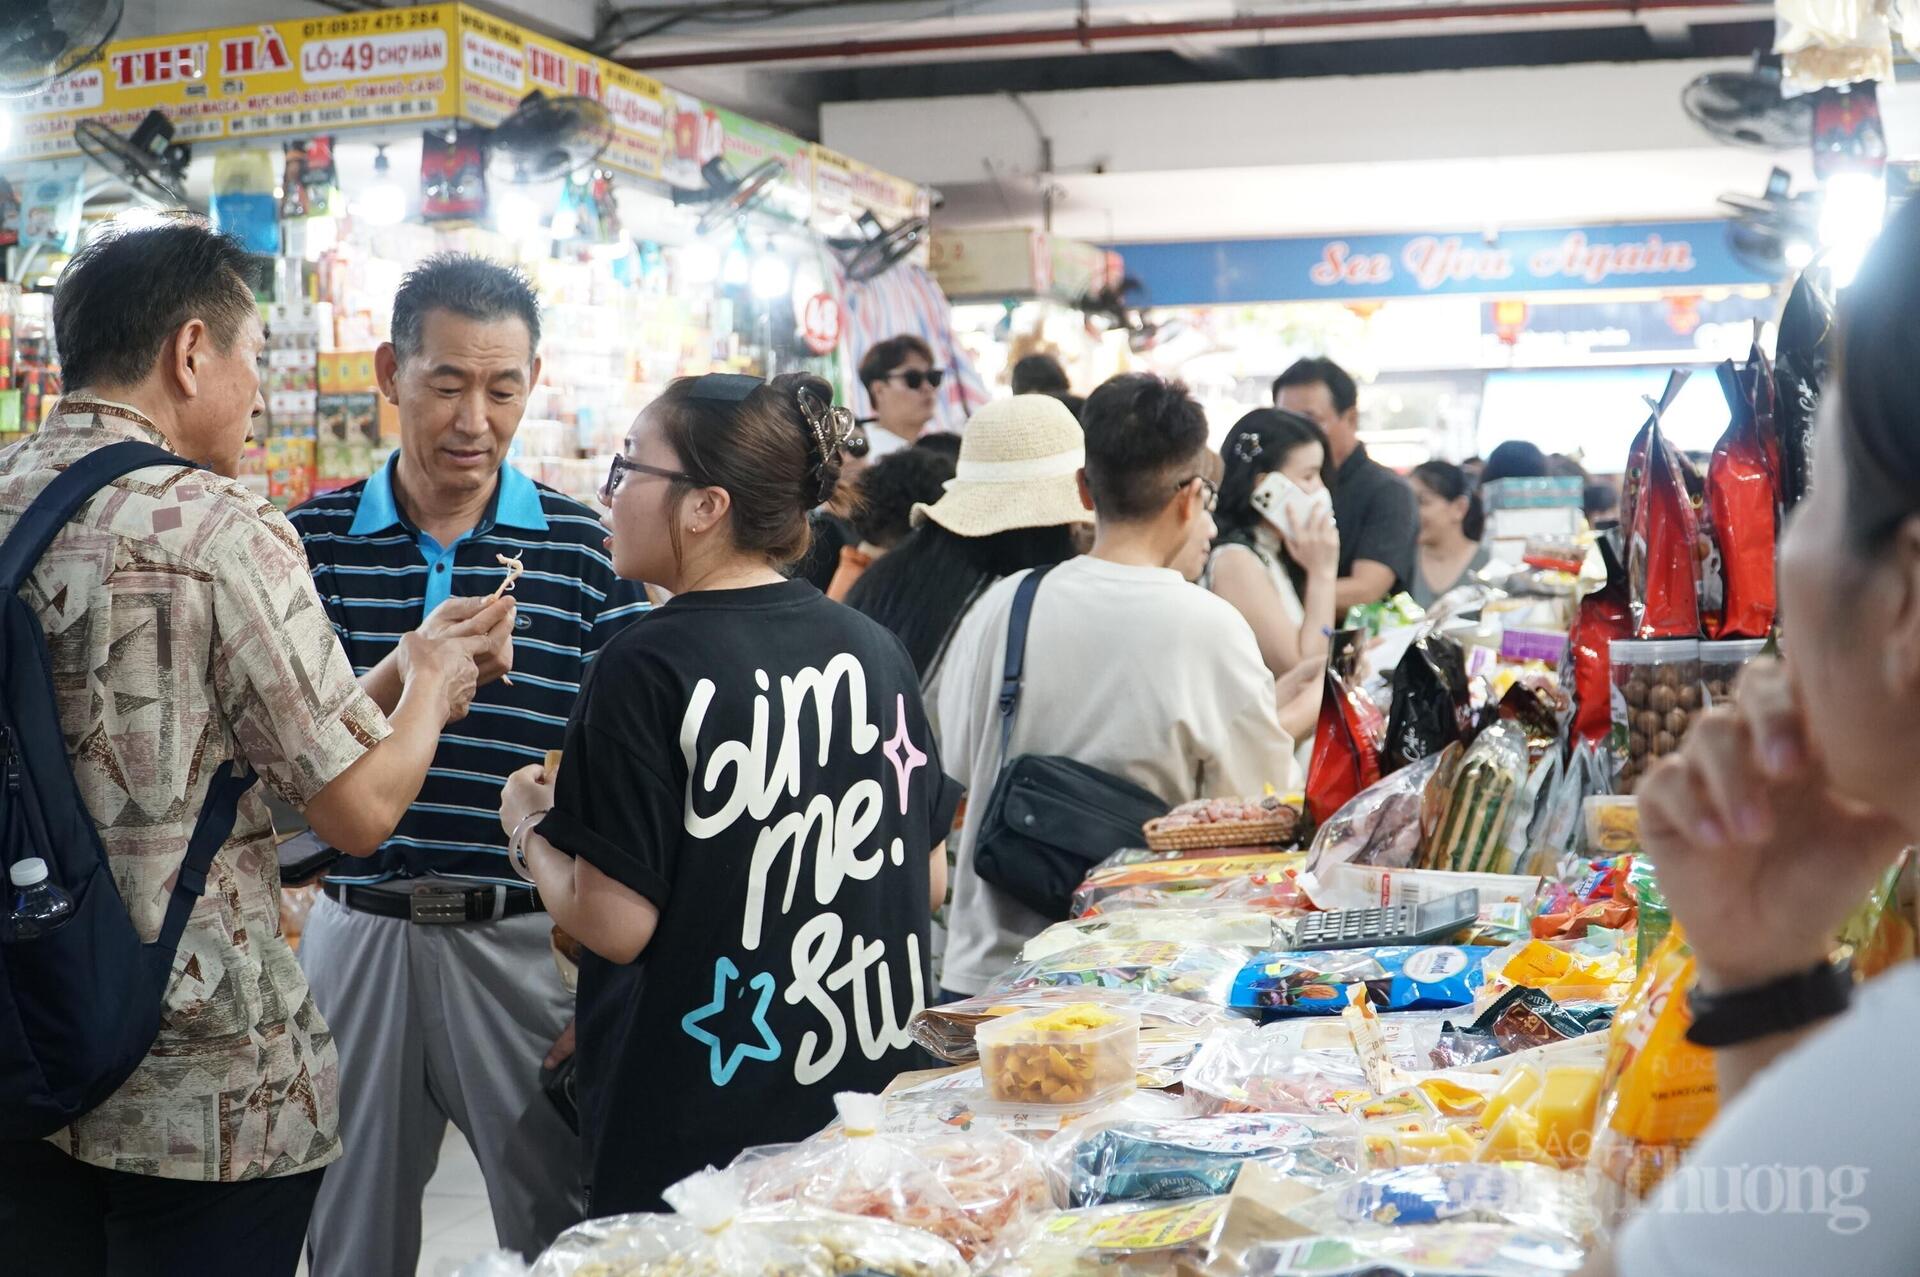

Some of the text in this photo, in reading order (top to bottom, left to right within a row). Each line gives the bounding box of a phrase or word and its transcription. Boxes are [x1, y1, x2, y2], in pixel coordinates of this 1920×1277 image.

[112, 26, 292, 89] THU HÀ
[1310, 231, 1696, 289] See You Again
